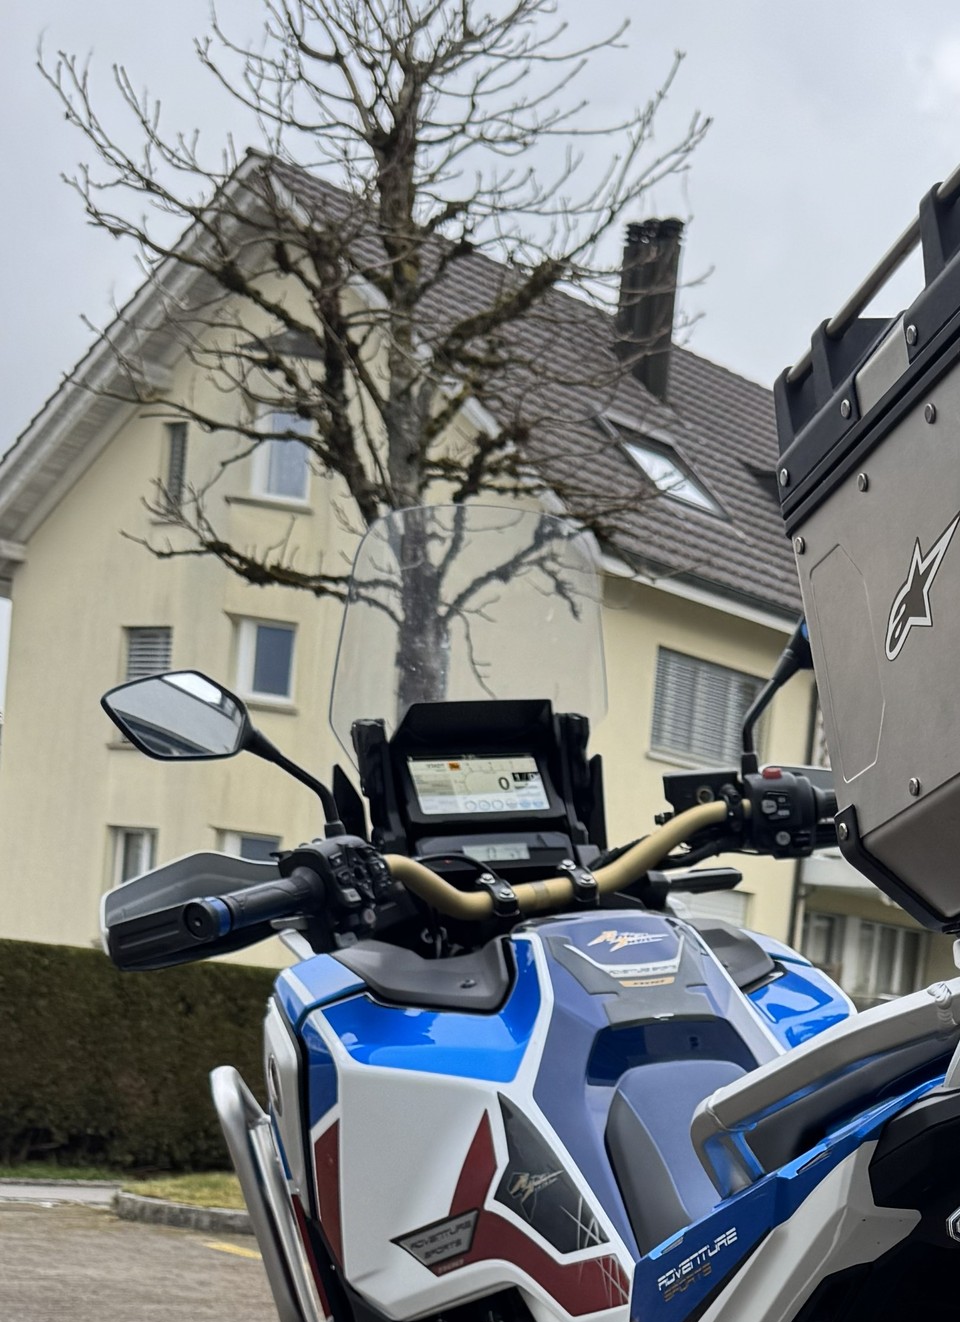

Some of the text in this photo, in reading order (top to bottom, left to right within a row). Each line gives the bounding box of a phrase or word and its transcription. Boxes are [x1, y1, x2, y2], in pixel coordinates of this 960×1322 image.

[498, 776, 510, 791] 0
[657, 1227, 738, 1291] ADVENTURE
[663, 1262, 712, 1302] SPORTS
